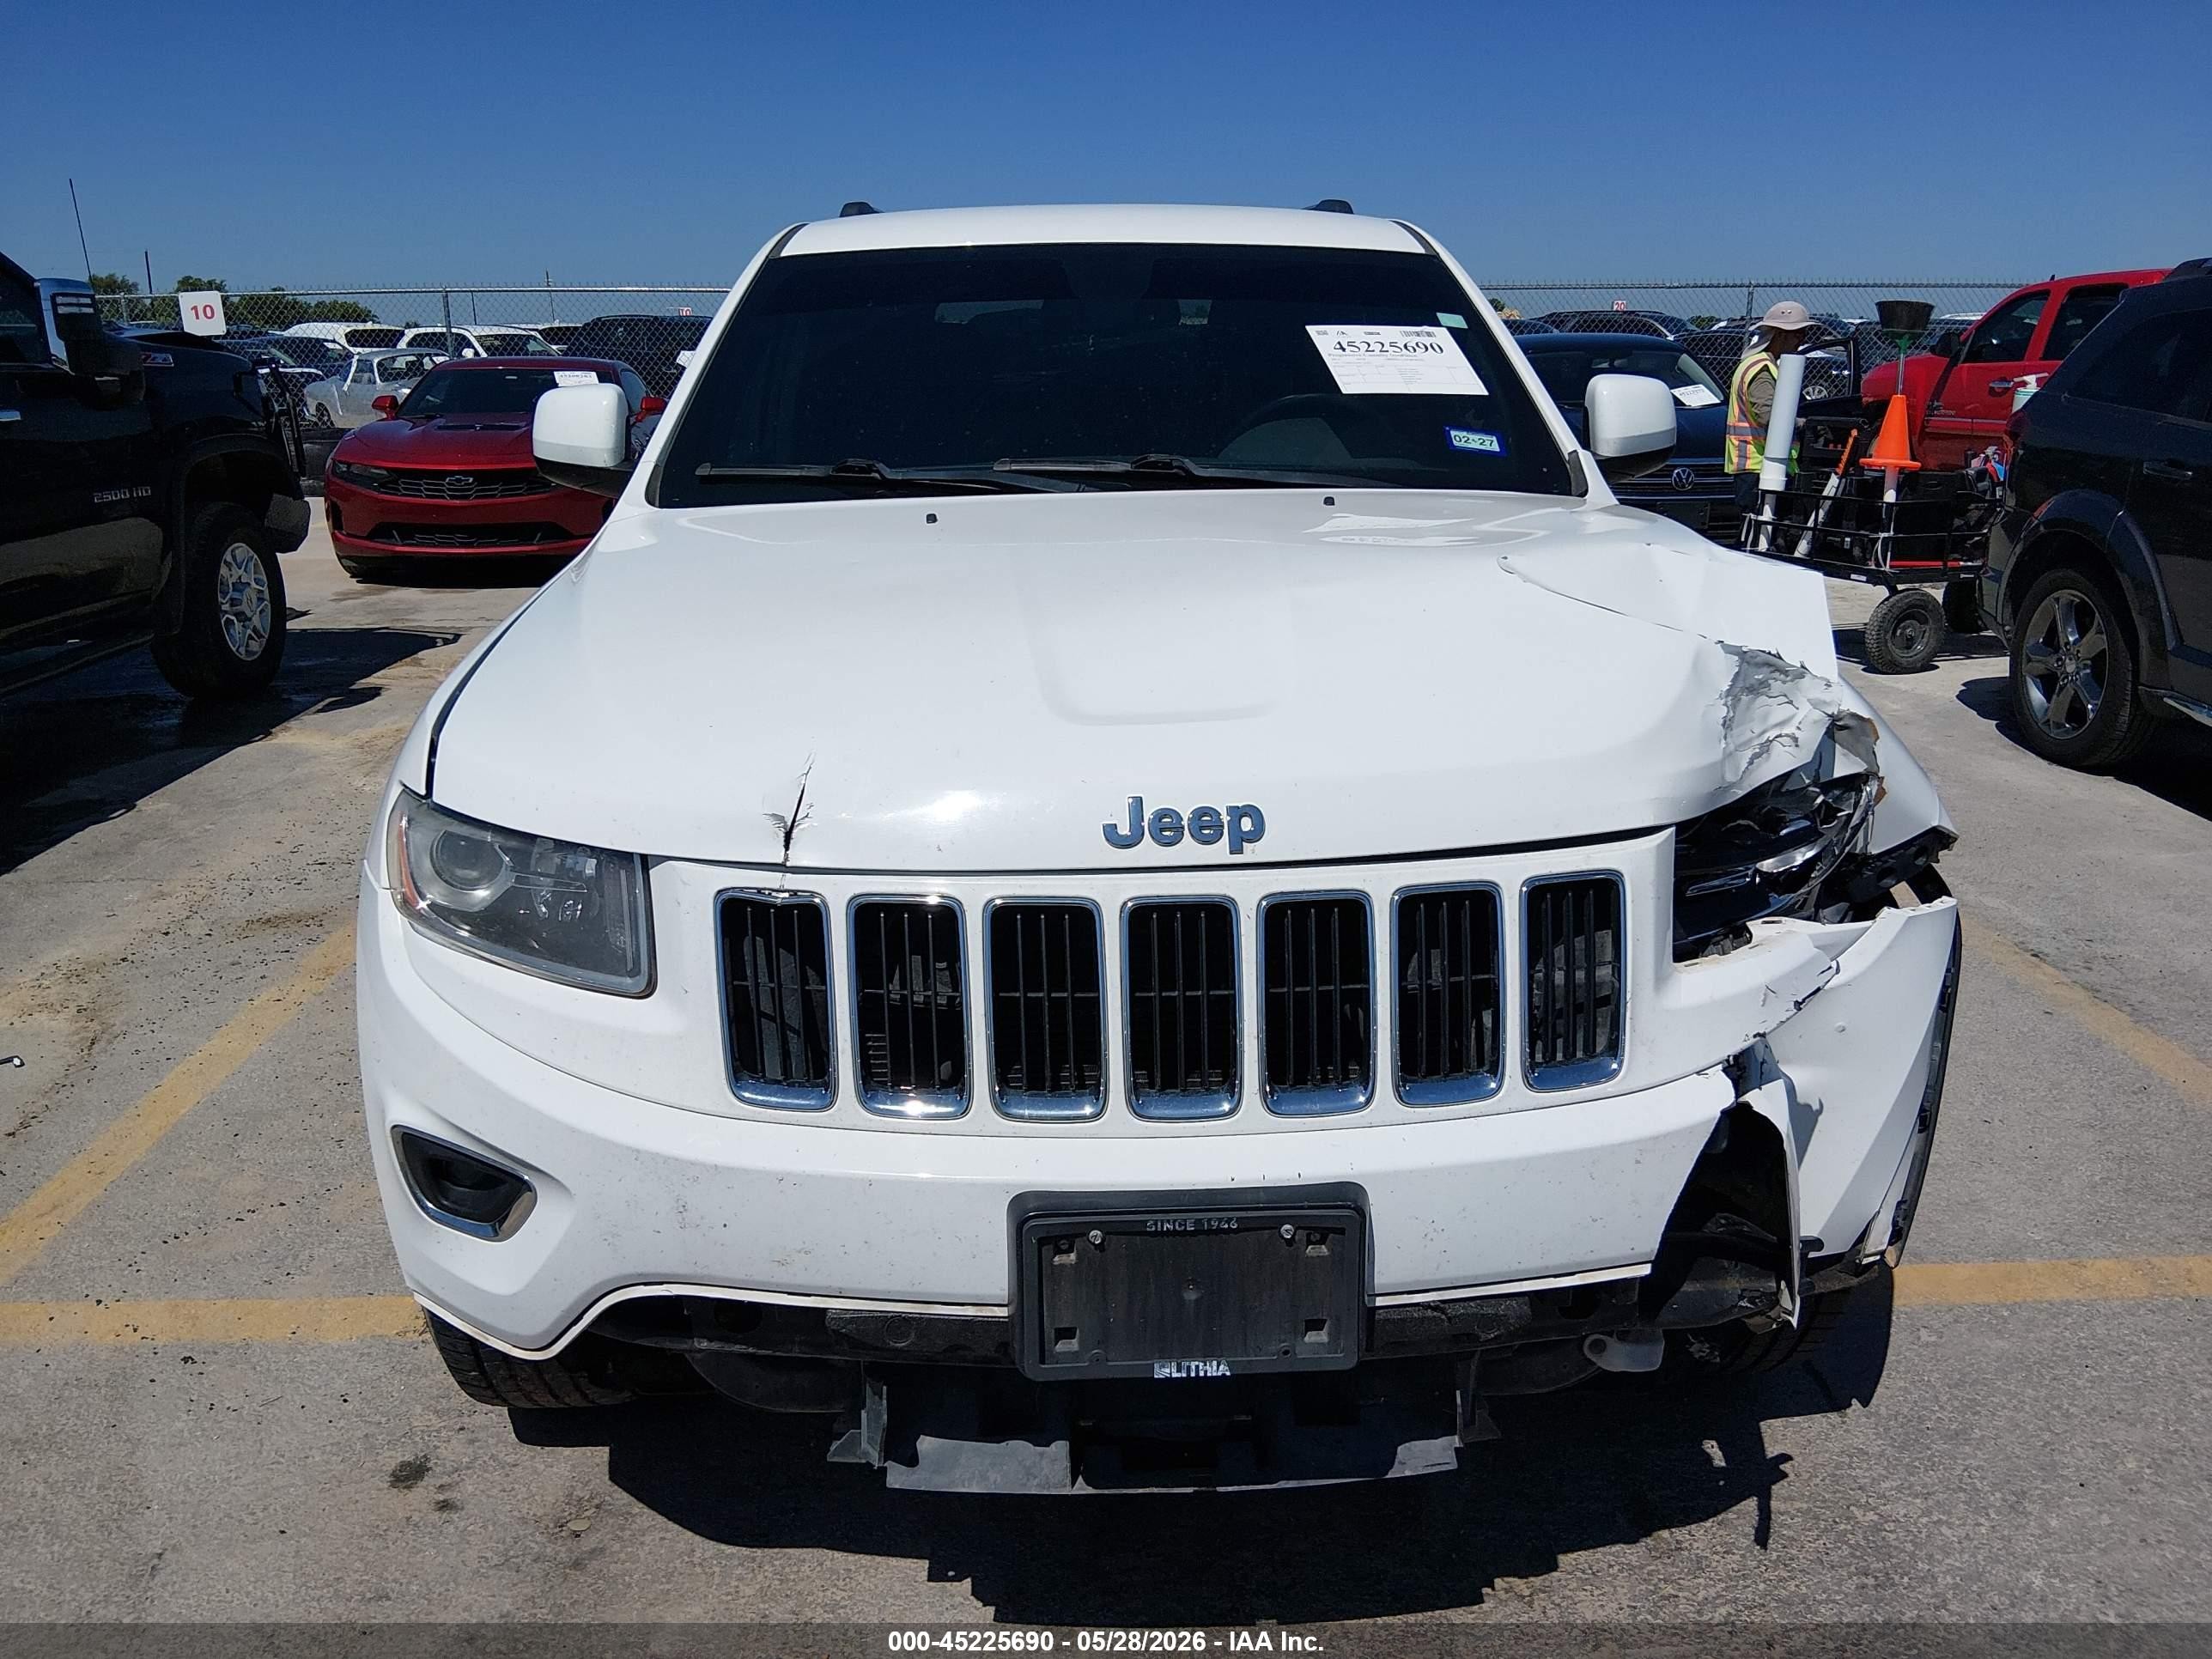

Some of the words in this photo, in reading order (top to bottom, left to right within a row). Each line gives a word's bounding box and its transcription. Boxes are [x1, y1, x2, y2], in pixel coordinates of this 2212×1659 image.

[191, 304, 215, 320] 10
[1333, 341, 1444, 354] 45225690
[94, 489, 131, 503] 2500
[1103, 796, 1267, 854] Jeep
[1146, 1219, 1195, 1231] SINCE
[1171, 1359, 1231, 1377] LITHIA
